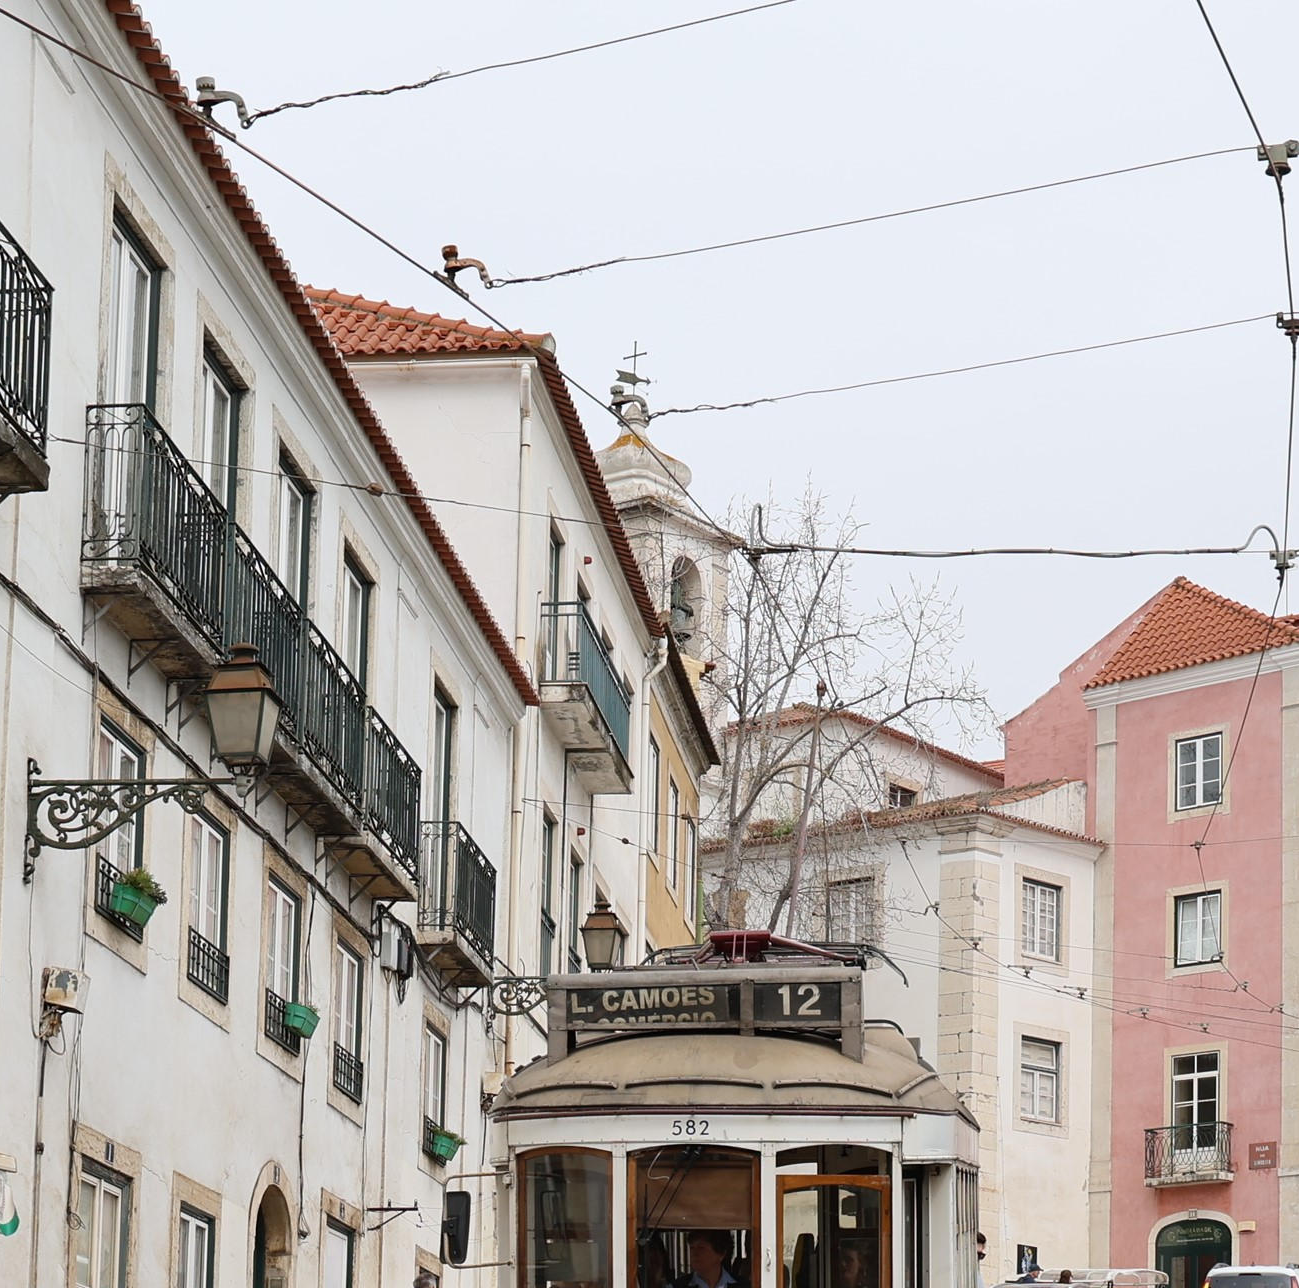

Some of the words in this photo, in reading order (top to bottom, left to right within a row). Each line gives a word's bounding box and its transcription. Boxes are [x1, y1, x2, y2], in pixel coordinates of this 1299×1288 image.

[571, 993, 594, 1014] L.
[778, 984, 821, 1016] 12
[672, 1119, 710, 1136] 582
